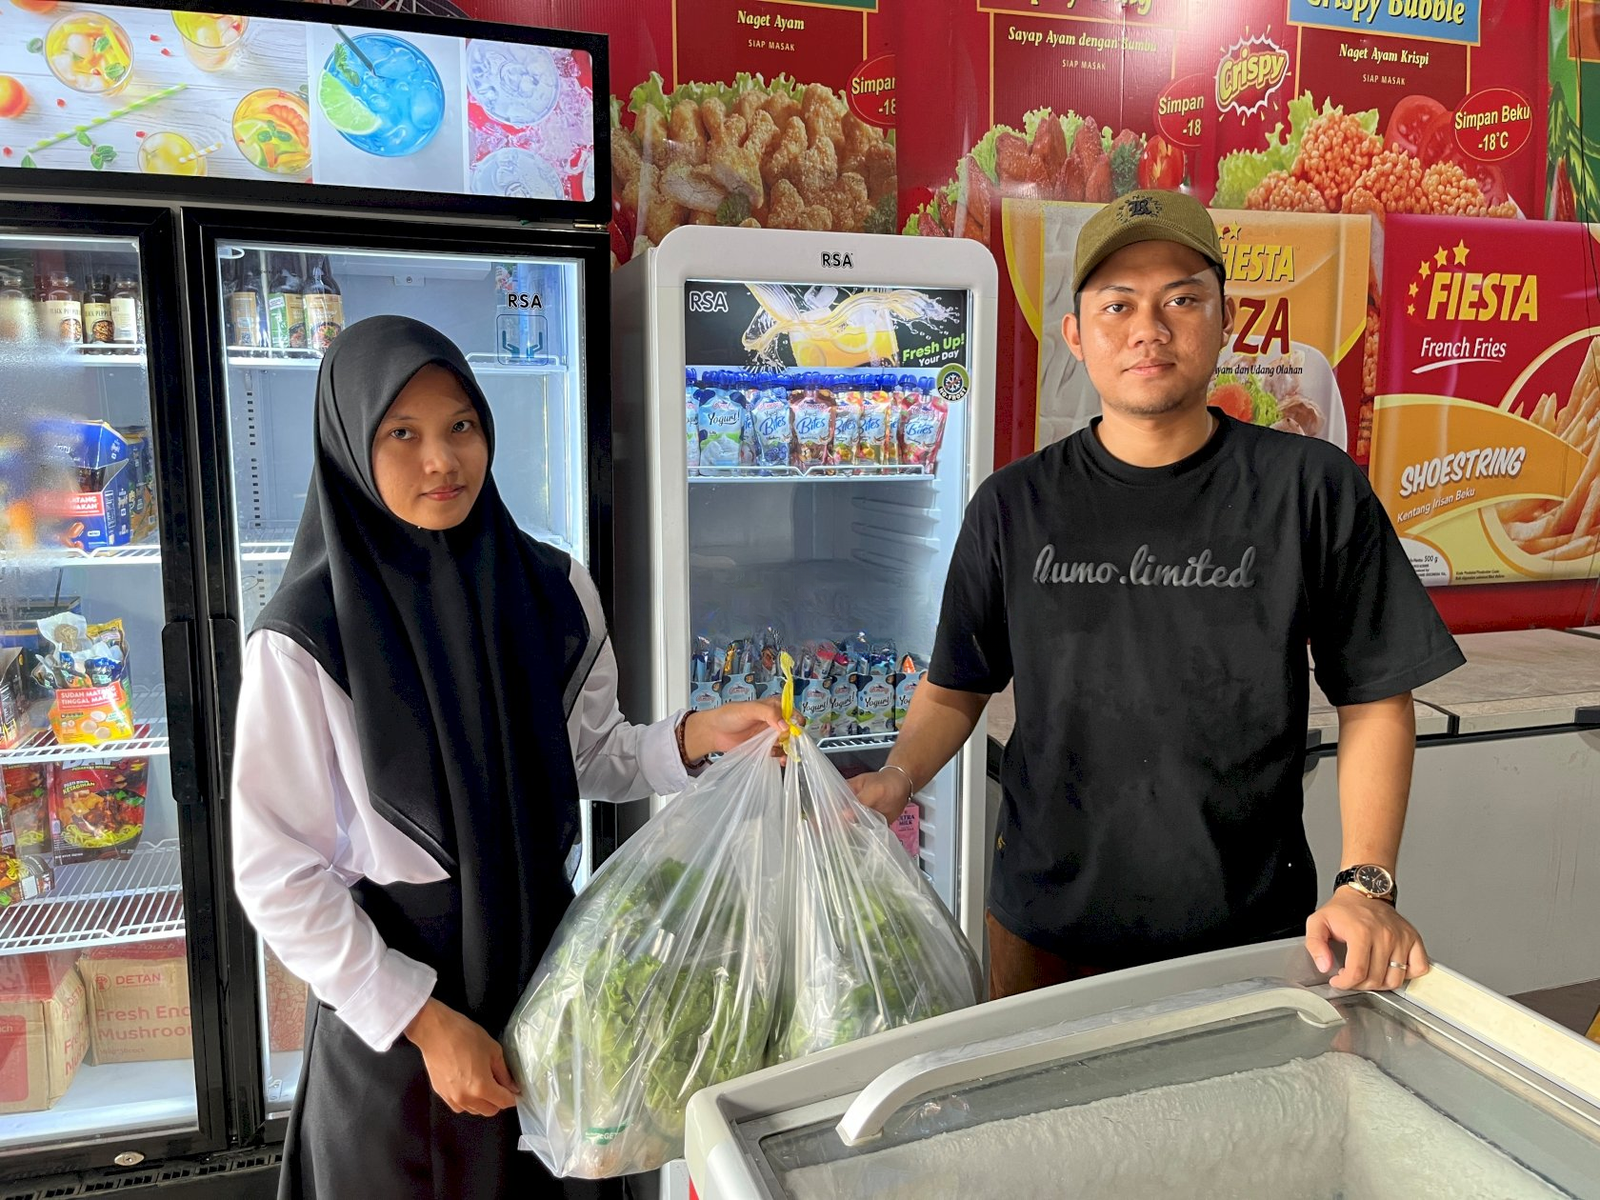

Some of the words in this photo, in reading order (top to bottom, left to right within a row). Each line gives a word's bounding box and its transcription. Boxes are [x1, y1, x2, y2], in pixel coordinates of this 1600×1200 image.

[737, 10, 771, 30] Naget
[773, 14, 805, 30] Ayam
[748, 38, 766, 48] SIAP
[768, 40, 795, 51] MASAK
[1008, 26, 1043, 46] Sayap
[1046, 30, 1076, 47] Ayam
[1079, 33, 1118, 51] dengan
[1120, 37, 1158, 52] Bumbu
[1062, 59, 1079, 68] SIAP
[1081, 61, 1106, 70] MASAK
[1339, 44, 1368, 62] Naget
[1371, 48, 1398, 64] Ayam
[1400, 50, 1429, 68] Krispi
[1219, 48, 1286, 99] Crispy
[1362, 73, 1379, 83] SIAP
[1381, 75, 1406, 86] MASAK
[1158, 95, 1204, 116] Simpan
[1455, 110, 1499, 130] Simpan
[1501, 104, 1531, 123] Beku
[1182, 119, 1202, 137] -18
[822, 253, 853, 268] RSA
[508, 293, 543, 309] RSA
[689, 291, 729, 312] RSA
[1426, 272, 1538, 322] FIESTA
[902, 341, 940, 361] Fresh
[943, 333, 965, 350] Up!
[1421, 337, 1470, 358] French
[1473, 338, 1507, 358] Fries
[919, 355, 940, 367] Your
[942, 350, 959, 361] Day
[1235, 364, 1250, 375] dan
[1250, 364, 1275, 377] Udang
[1276, 364, 1303, 375] Olahan
[759, 415, 787, 436] Bites
[796, 416, 826, 435] Bites
[1399, 446, 1527, 498] SHOESTRING
[1397, 503, 1431, 523] Kentang
[1432, 496, 1454, 511] Irisan
[1455, 487, 1476, 501] Beku
[116, 974, 162, 985] DETAN
[96, 1006, 150, 1022] Fresh
[156, 1005, 190, 1019] Eno
